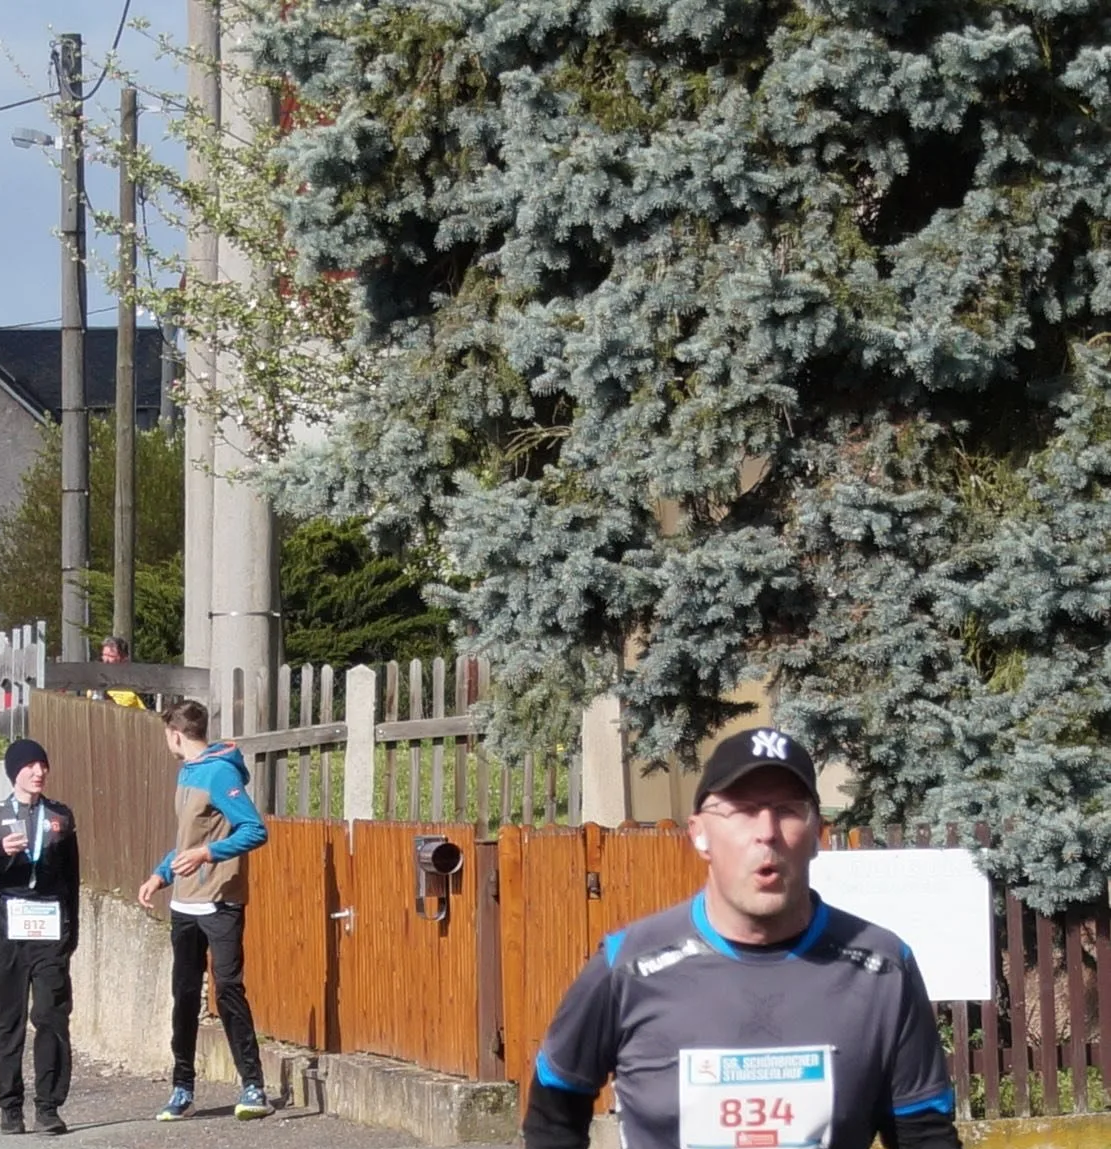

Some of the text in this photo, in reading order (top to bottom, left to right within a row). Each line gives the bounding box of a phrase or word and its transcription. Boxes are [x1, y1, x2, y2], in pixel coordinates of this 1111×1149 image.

[752, 731, 787, 760] NY
[24, 919, 47, 930] 812
[720, 1098, 794, 1127] 834
